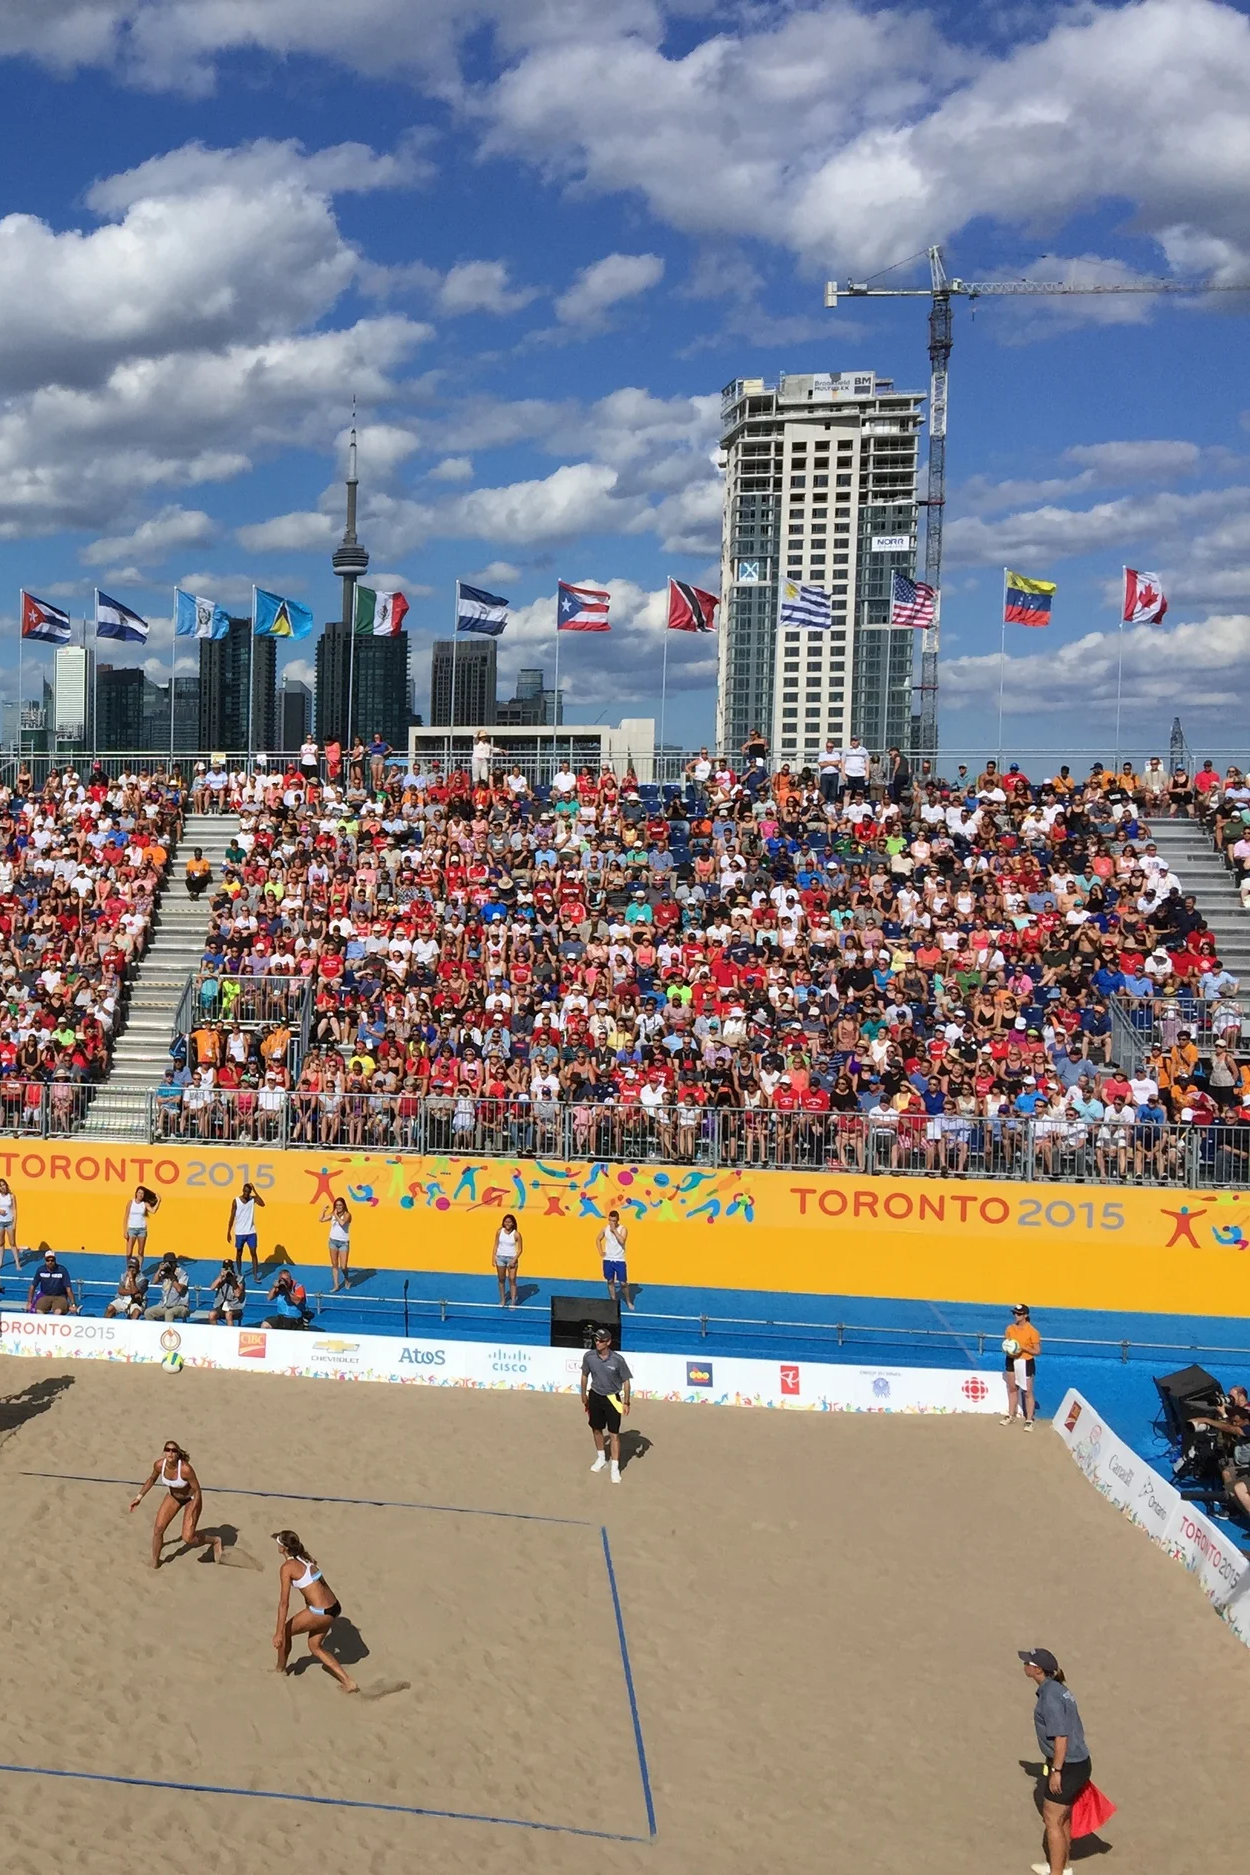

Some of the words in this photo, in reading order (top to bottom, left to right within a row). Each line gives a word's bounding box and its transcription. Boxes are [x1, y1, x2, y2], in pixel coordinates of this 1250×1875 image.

[854, 377, 872, 385] BM
[186, 1160, 275, 1189] 2015
[790, 1188, 1010, 1224] TORONTO
[1017, 1198, 1125, 1231] 2015
[74, 1325, 115, 1340] 2015
[241, 1333, 265, 1345] CIBC
[311, 1355, 360, 1364] CHEVROLET
[492, 1362, 528, 1373] CISCO
[1180, 1515, 1222, 1568] TORONTO
[1218, 1557, 1241, 1590] 2015
